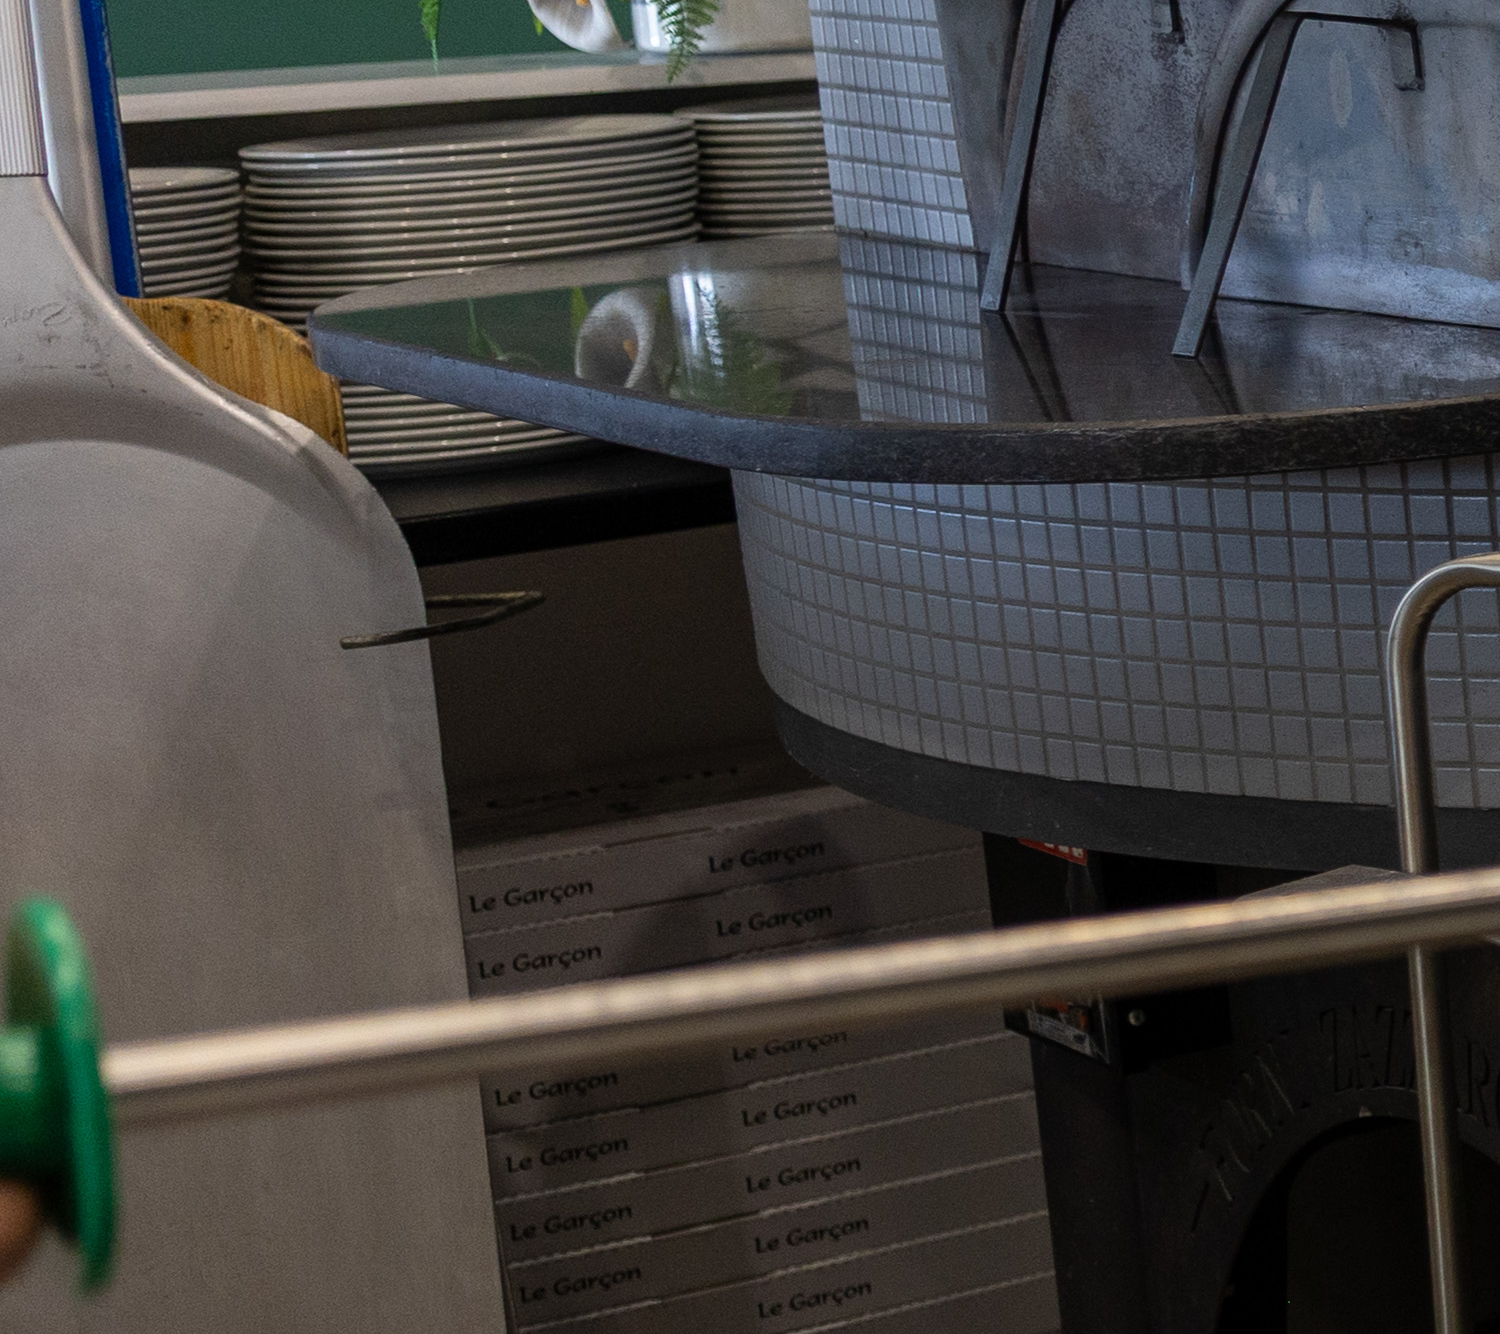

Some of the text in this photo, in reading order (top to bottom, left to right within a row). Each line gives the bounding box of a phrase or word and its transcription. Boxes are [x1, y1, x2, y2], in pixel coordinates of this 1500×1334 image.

[708, 841, 826, 873] Le Garçon
[468, 880, 595, 914] Le Garçon
[716, 906, 834, 939] Le Garçon
[478, 945, 604, 980] Le Garçon
[732, 1031, 847, 1062] Le Garçon
[494, 1072, 620, 1107] Le Garçon
[742, 1092, 857, 1127] Le Garçon
[506, 1138, 628, 1173] Le Garçon
[745, 1158, 861, 1193] Le Garçon
[509, 1205, 632, 1242] Le Garçon
[754, 1218, 869, 1254] Le Garçon
[519, 1267, 642, 1304] Le Garçon
[757, 1282, 872, 1319] Le Garçon
